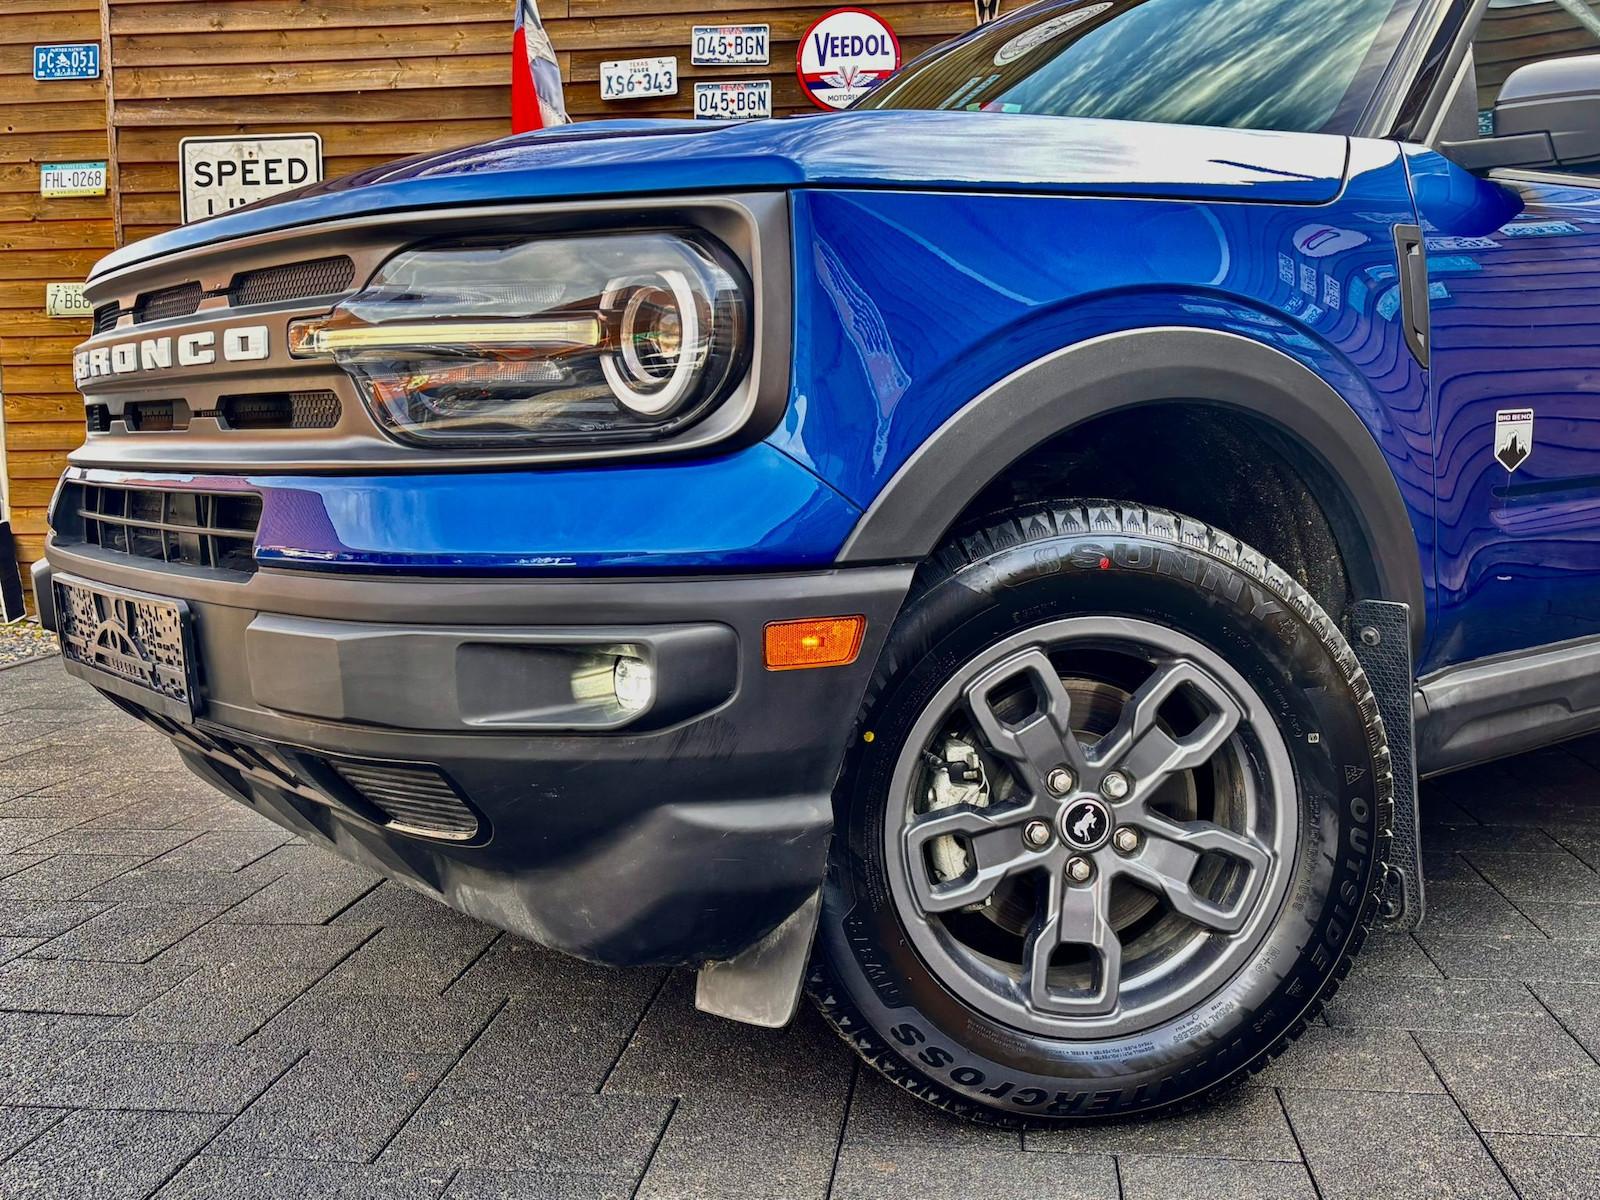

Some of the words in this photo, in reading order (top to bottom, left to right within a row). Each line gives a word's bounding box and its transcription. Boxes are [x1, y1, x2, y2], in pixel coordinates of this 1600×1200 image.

[39, 52, 55, 69] PC
[71, 51, 96, 68] 051
[697, 36, 727, 56] 045
[735, 35, 765, 56] BGN
[814, 32, 890, 67] VEEDOL
[605, 74, 635, 95] XS6
[643, 70, 673, 91] 343
[699, 92, 729, 112] 045
[737, 91, 766, 112] BGN
[194, 158, 309, 188] SPEED
[75, 325, 270, 380] BRONCO
[1071, 543, 1284, 621] SUNNY
[1310, 797, 1370, 972] OUTSIDE
[1254, 945, 1281, 976] M+S
